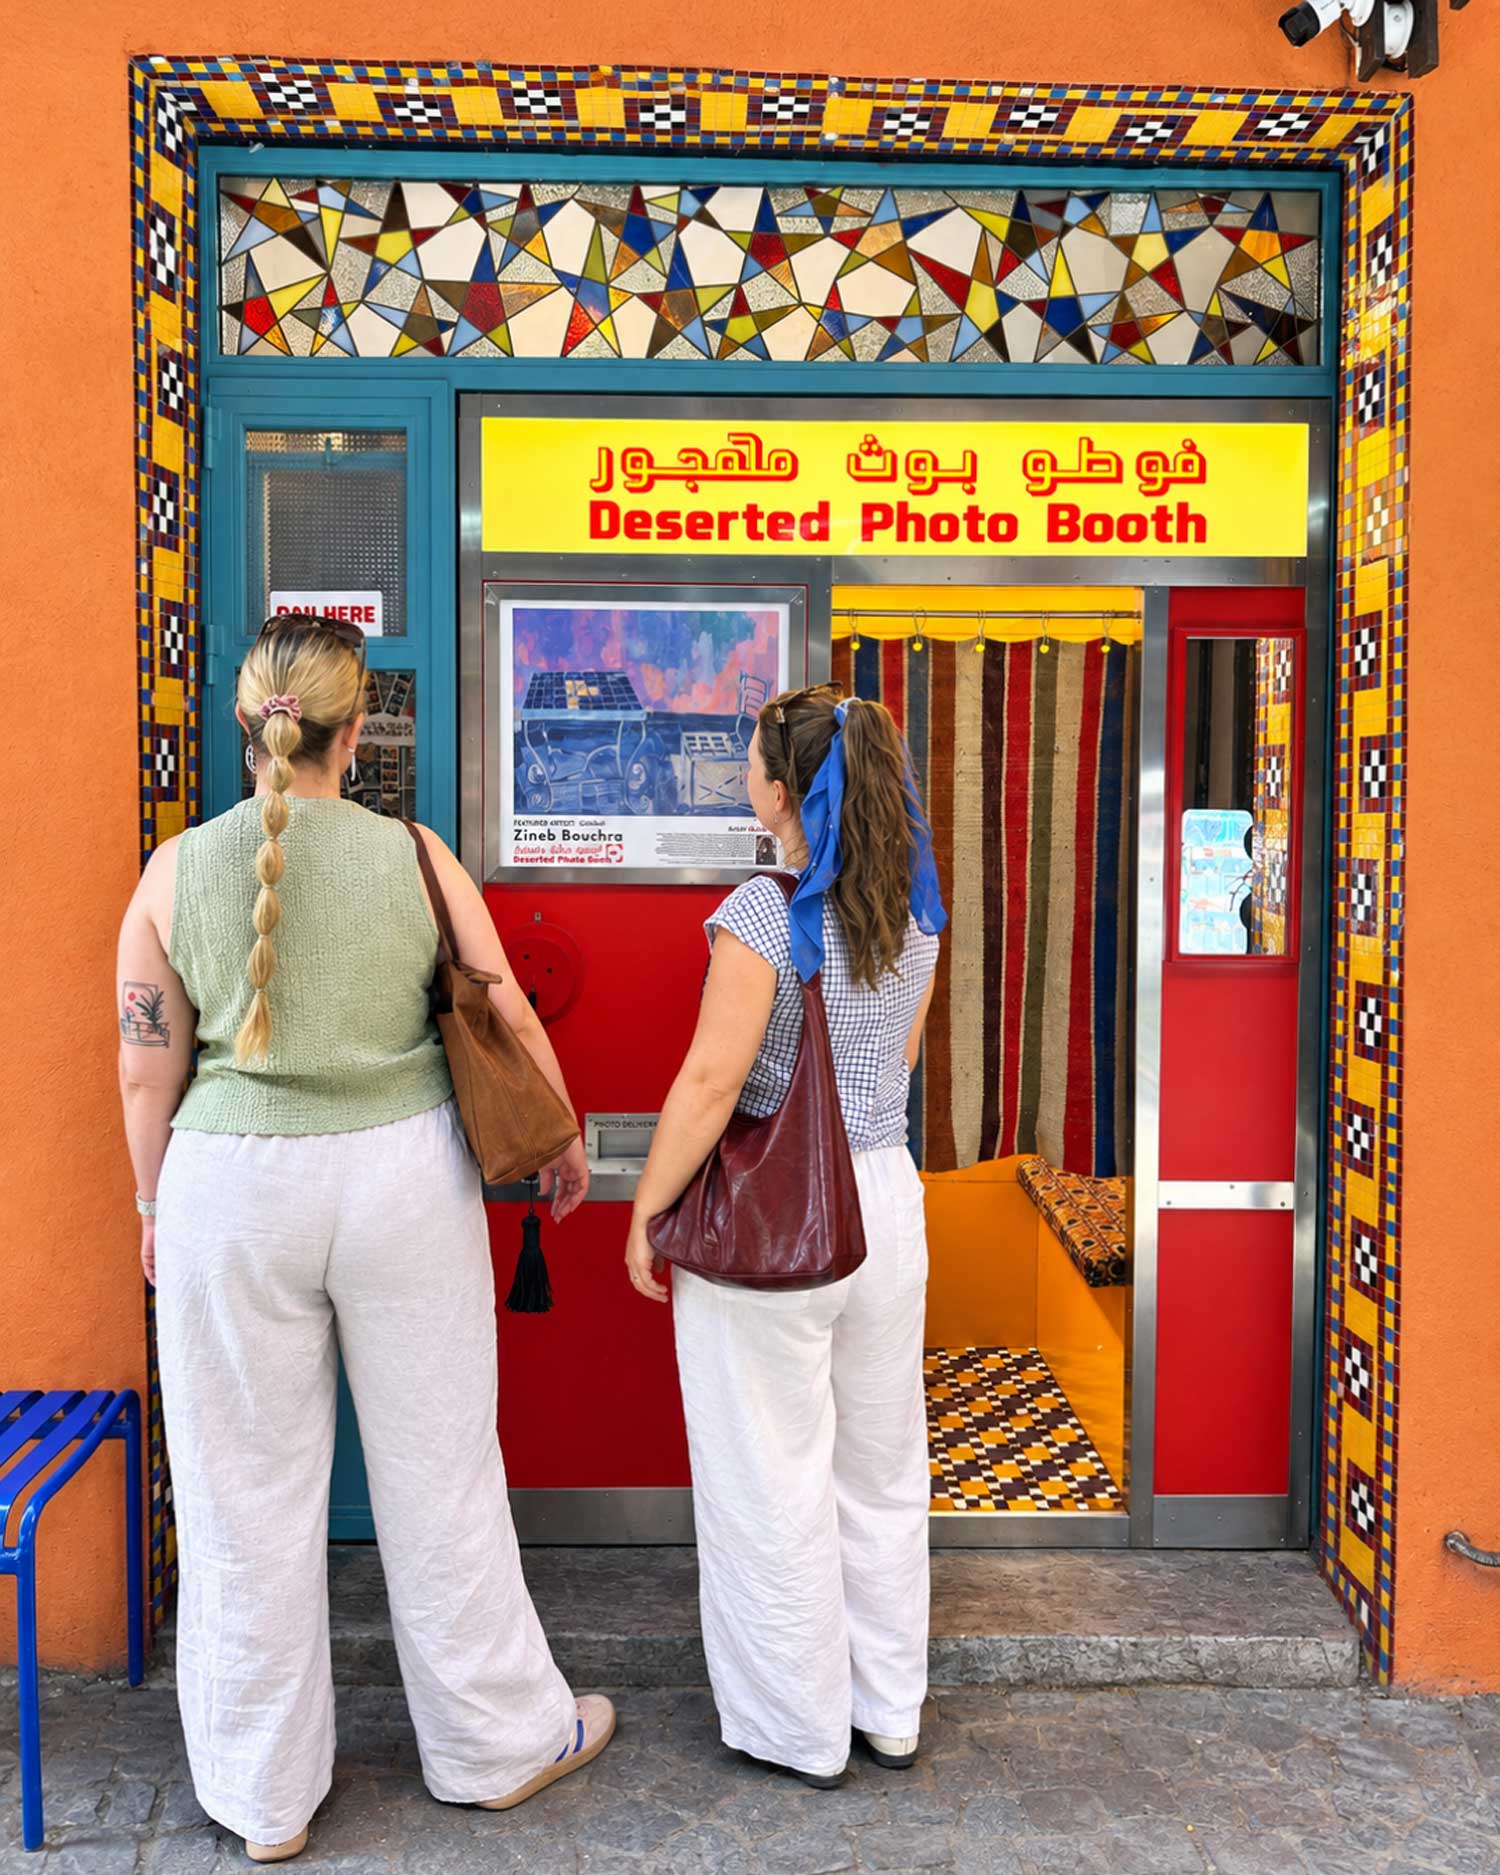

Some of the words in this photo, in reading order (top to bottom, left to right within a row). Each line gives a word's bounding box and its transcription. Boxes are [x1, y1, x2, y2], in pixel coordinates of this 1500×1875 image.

[846, 434, 978, 497] بوث
[589, 500, 830, 542] Deserted
[861, 500, 1019, 543] Photo
[1046, 501, 1207, 544] Booth
[323, 605, 376, 623] HERE
[513, 828, 556, 841] Zineb
[561, 829, 623, 842] Bouchra
[513, 855, 555, 863] Deserted
